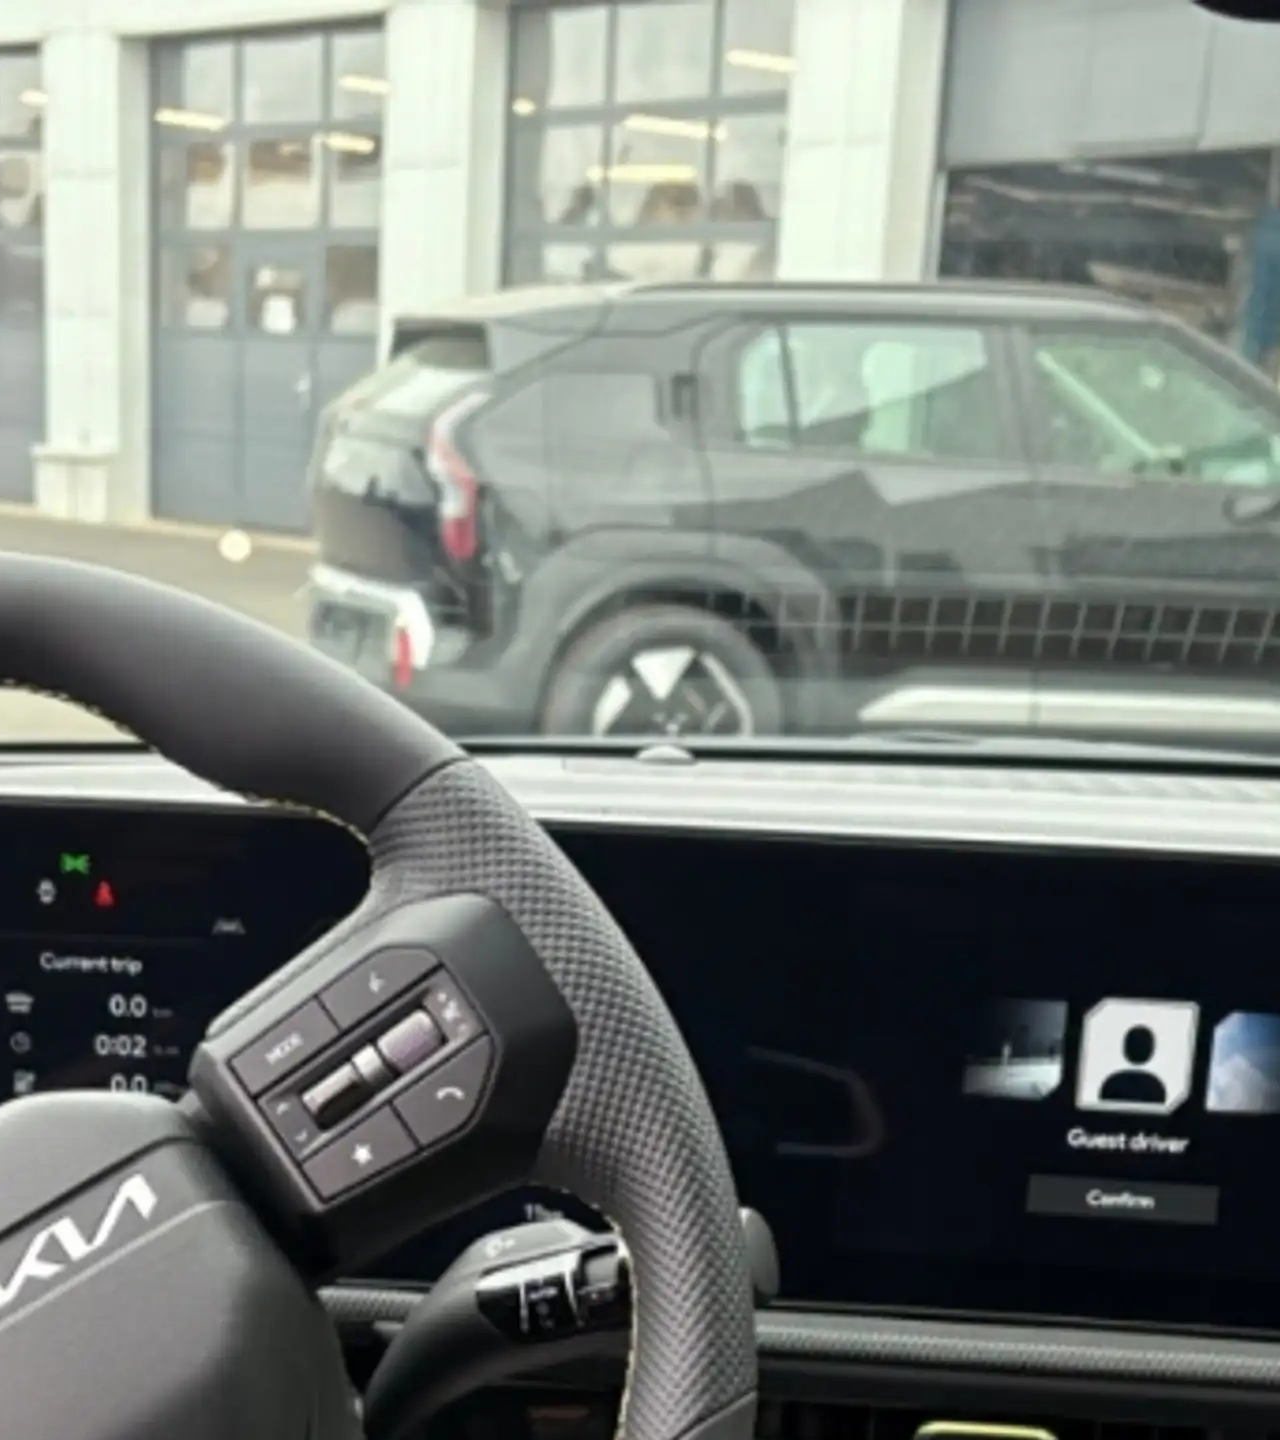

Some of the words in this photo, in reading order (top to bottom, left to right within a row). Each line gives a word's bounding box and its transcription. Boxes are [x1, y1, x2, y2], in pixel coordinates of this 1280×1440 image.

[39, 951, 108, 974] Current
[111, 956, 144, 977] trip
[108, 992, 149, 1019] 0.0
[94, 1033, 149, 1058] 0:02
[1066, 1125, 1126, 1150] Guest
[1129, 1130, 1190, 1153] driver
[1084, 1187, 1156, 1210] Confirm
